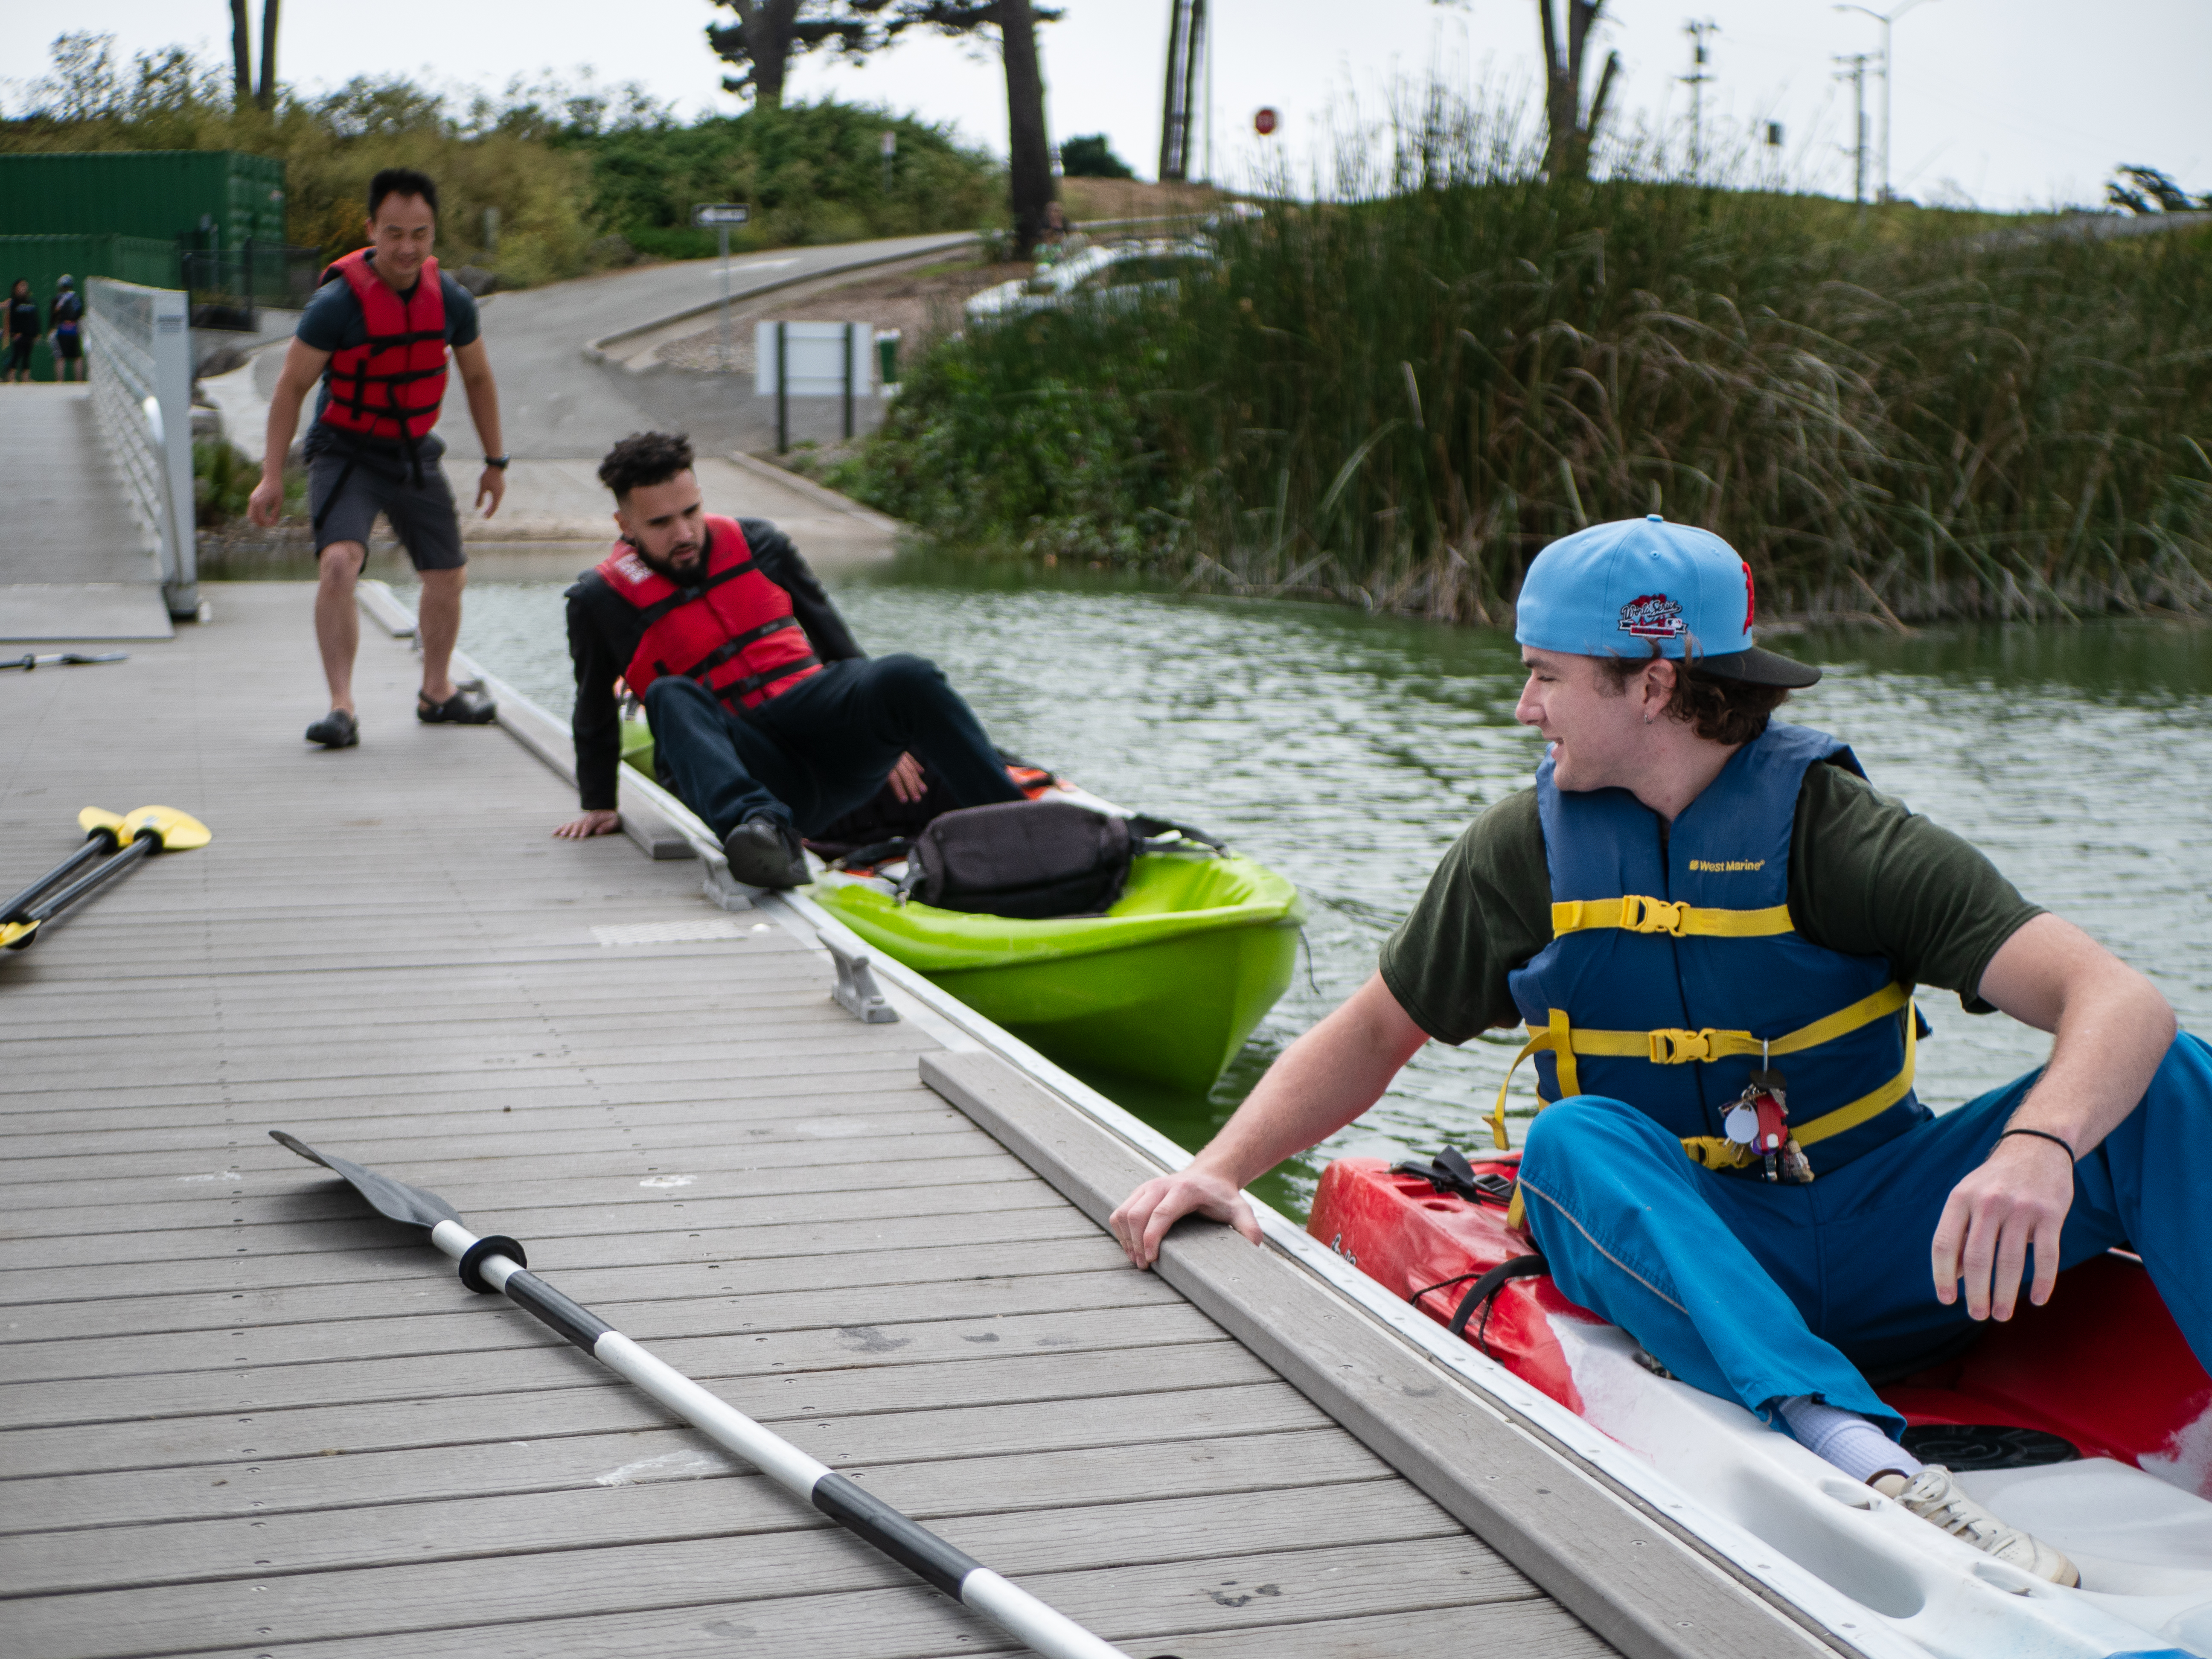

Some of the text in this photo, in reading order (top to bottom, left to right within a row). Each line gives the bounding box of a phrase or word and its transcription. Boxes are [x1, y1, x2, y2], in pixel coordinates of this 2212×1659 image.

[1622, 599, 1681, 620] World Series
[1700, 860, 1724, 872] West
